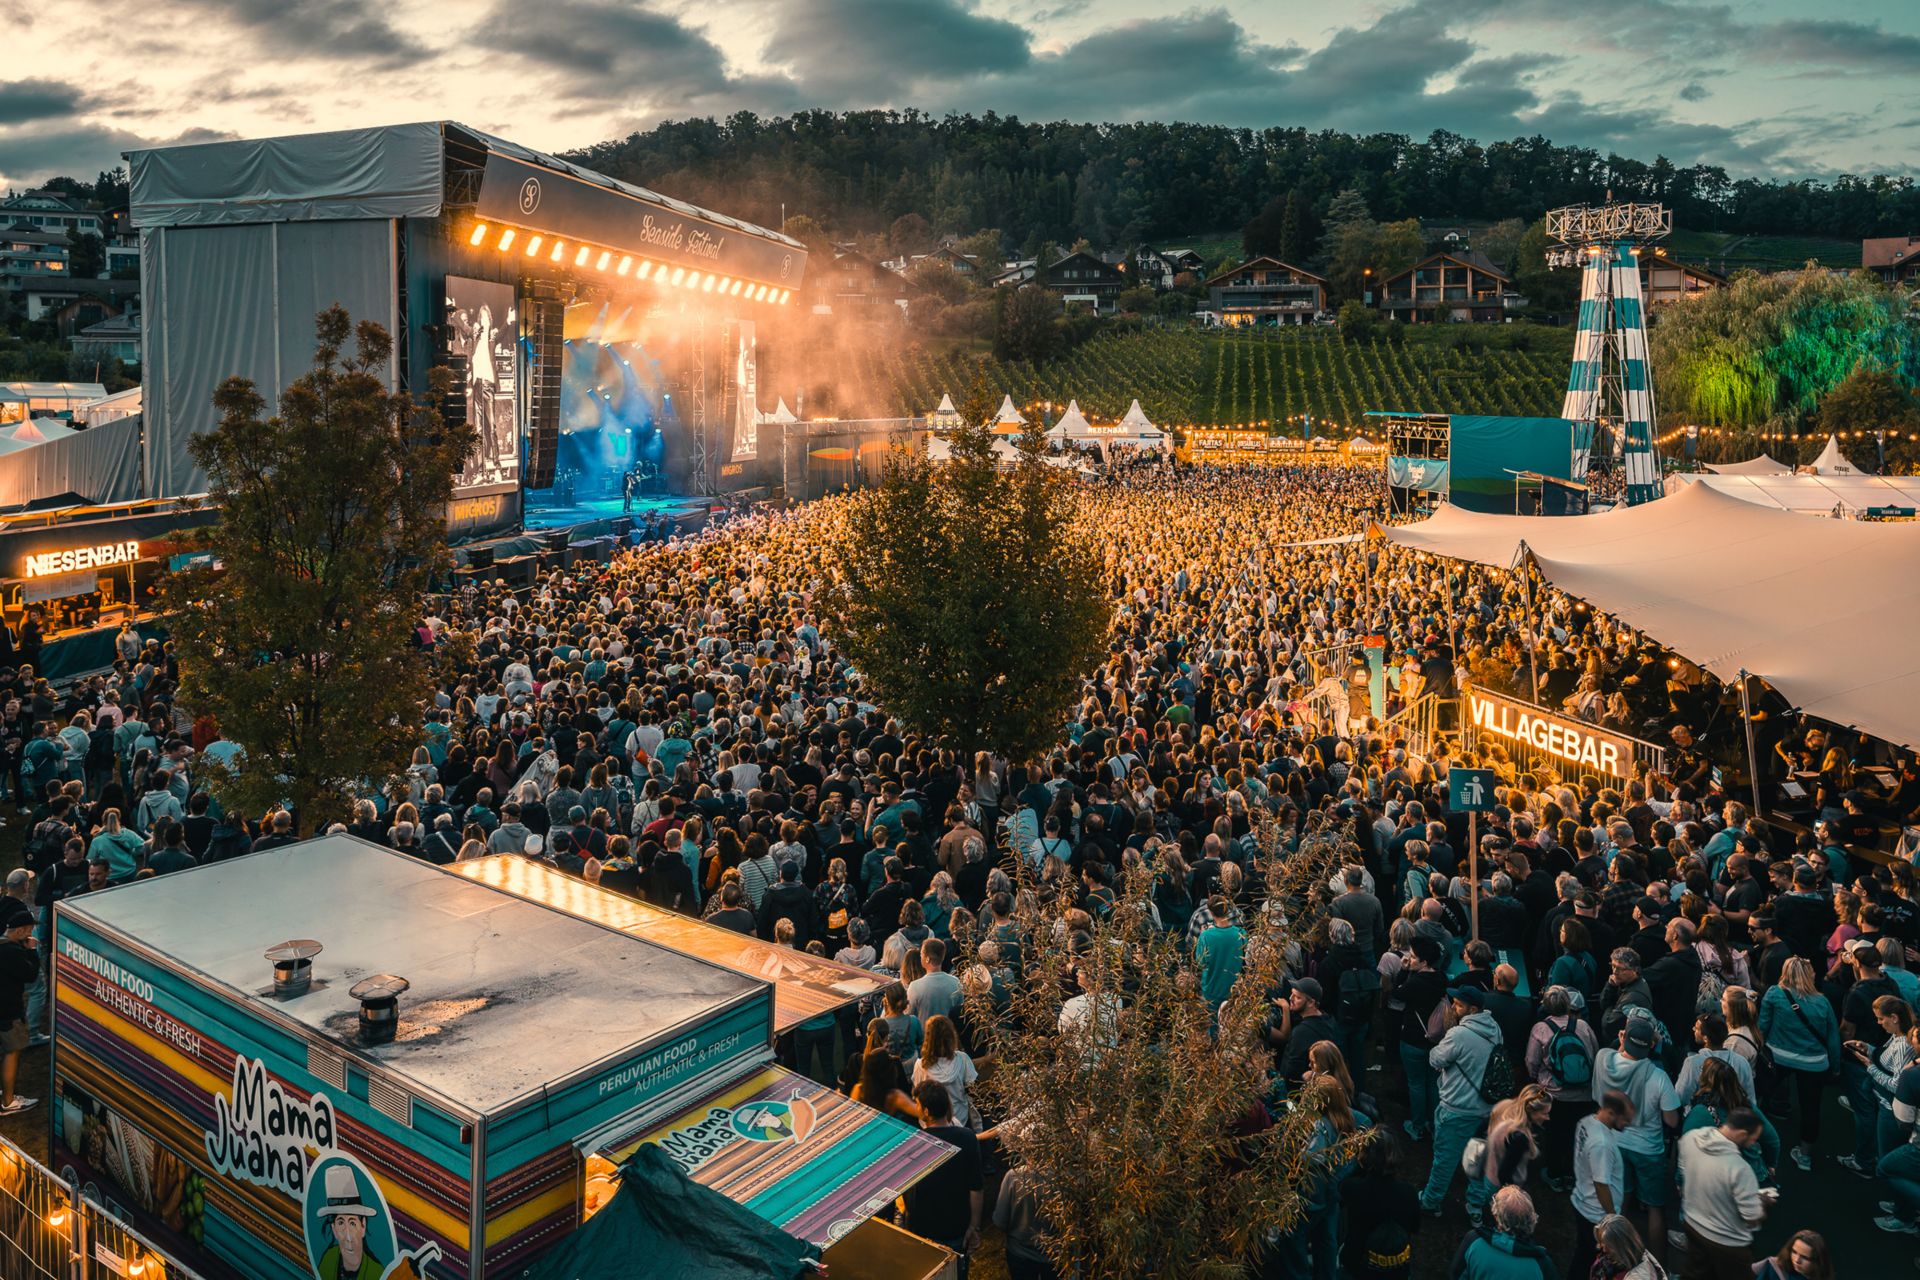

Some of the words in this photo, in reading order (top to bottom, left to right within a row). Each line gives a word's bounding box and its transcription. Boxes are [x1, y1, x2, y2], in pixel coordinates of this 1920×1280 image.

[640, 214, 682, 250] Seaside
[685, 229, 725, 260] Festival
[722, 463, 742, 477] MIGROS
[454, 500, 496, 521] MIGROS
[26, 541, 140, 578] NIESENBAR
[1470, 695, 1619, 777] VILLAGEBAR
[66, 939, 119, 985] PERUVIAN
[121, 969, 154, 1003] FOOD
[95, 980, 153, 1029] AUTHENTIC
[154, 1013, 164, 1034] &
[165, 1020, 201, 1058] FRESH
[599, 1054, 662, 1096] PERUVIAN
[664, 1038, 697, 1065] FOOD
[634, 1053, 697, 1095] AUTHENTIC
[698, 1049, 706, 1063] &
[708, 1032, 740, 1058] FRESH
[235, 1062, 333, 1149] Mama
[661, 1108, 732, 1155] Mama
[209, 1098, 304, 1194] Juana
